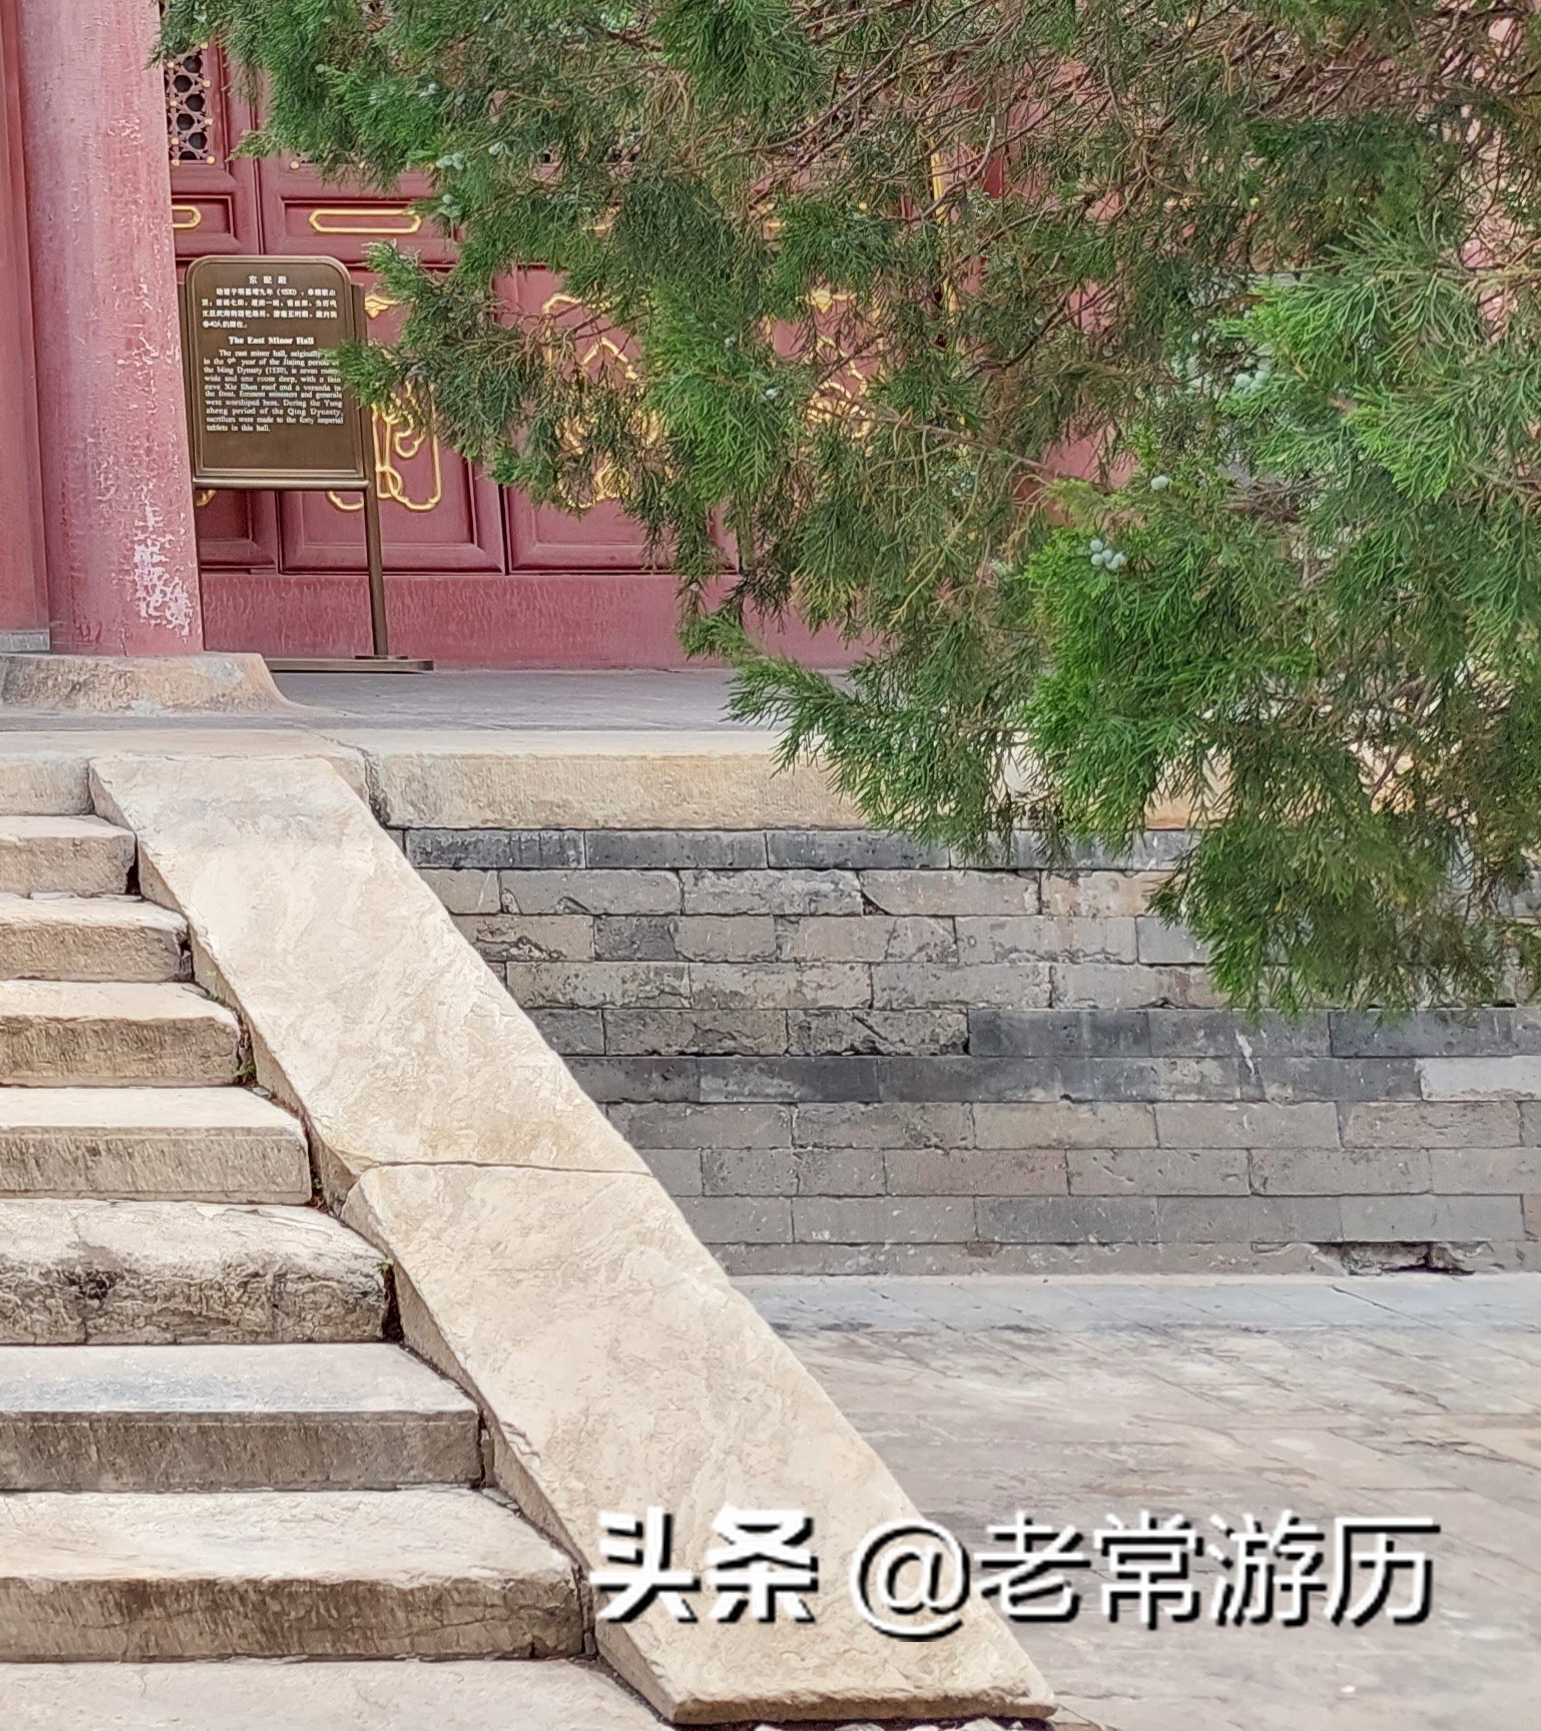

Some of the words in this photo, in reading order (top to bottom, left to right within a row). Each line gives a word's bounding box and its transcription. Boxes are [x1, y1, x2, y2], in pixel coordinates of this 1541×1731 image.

[228, 336, 244, 345] The
[247, 336, 265, 345] East
[268, 336, 293, 345] Minor
[296, 336, 314, 345] Hall
[237, 367, 262, 375] Dynasty
[287, 408, 306, 417] Qing
